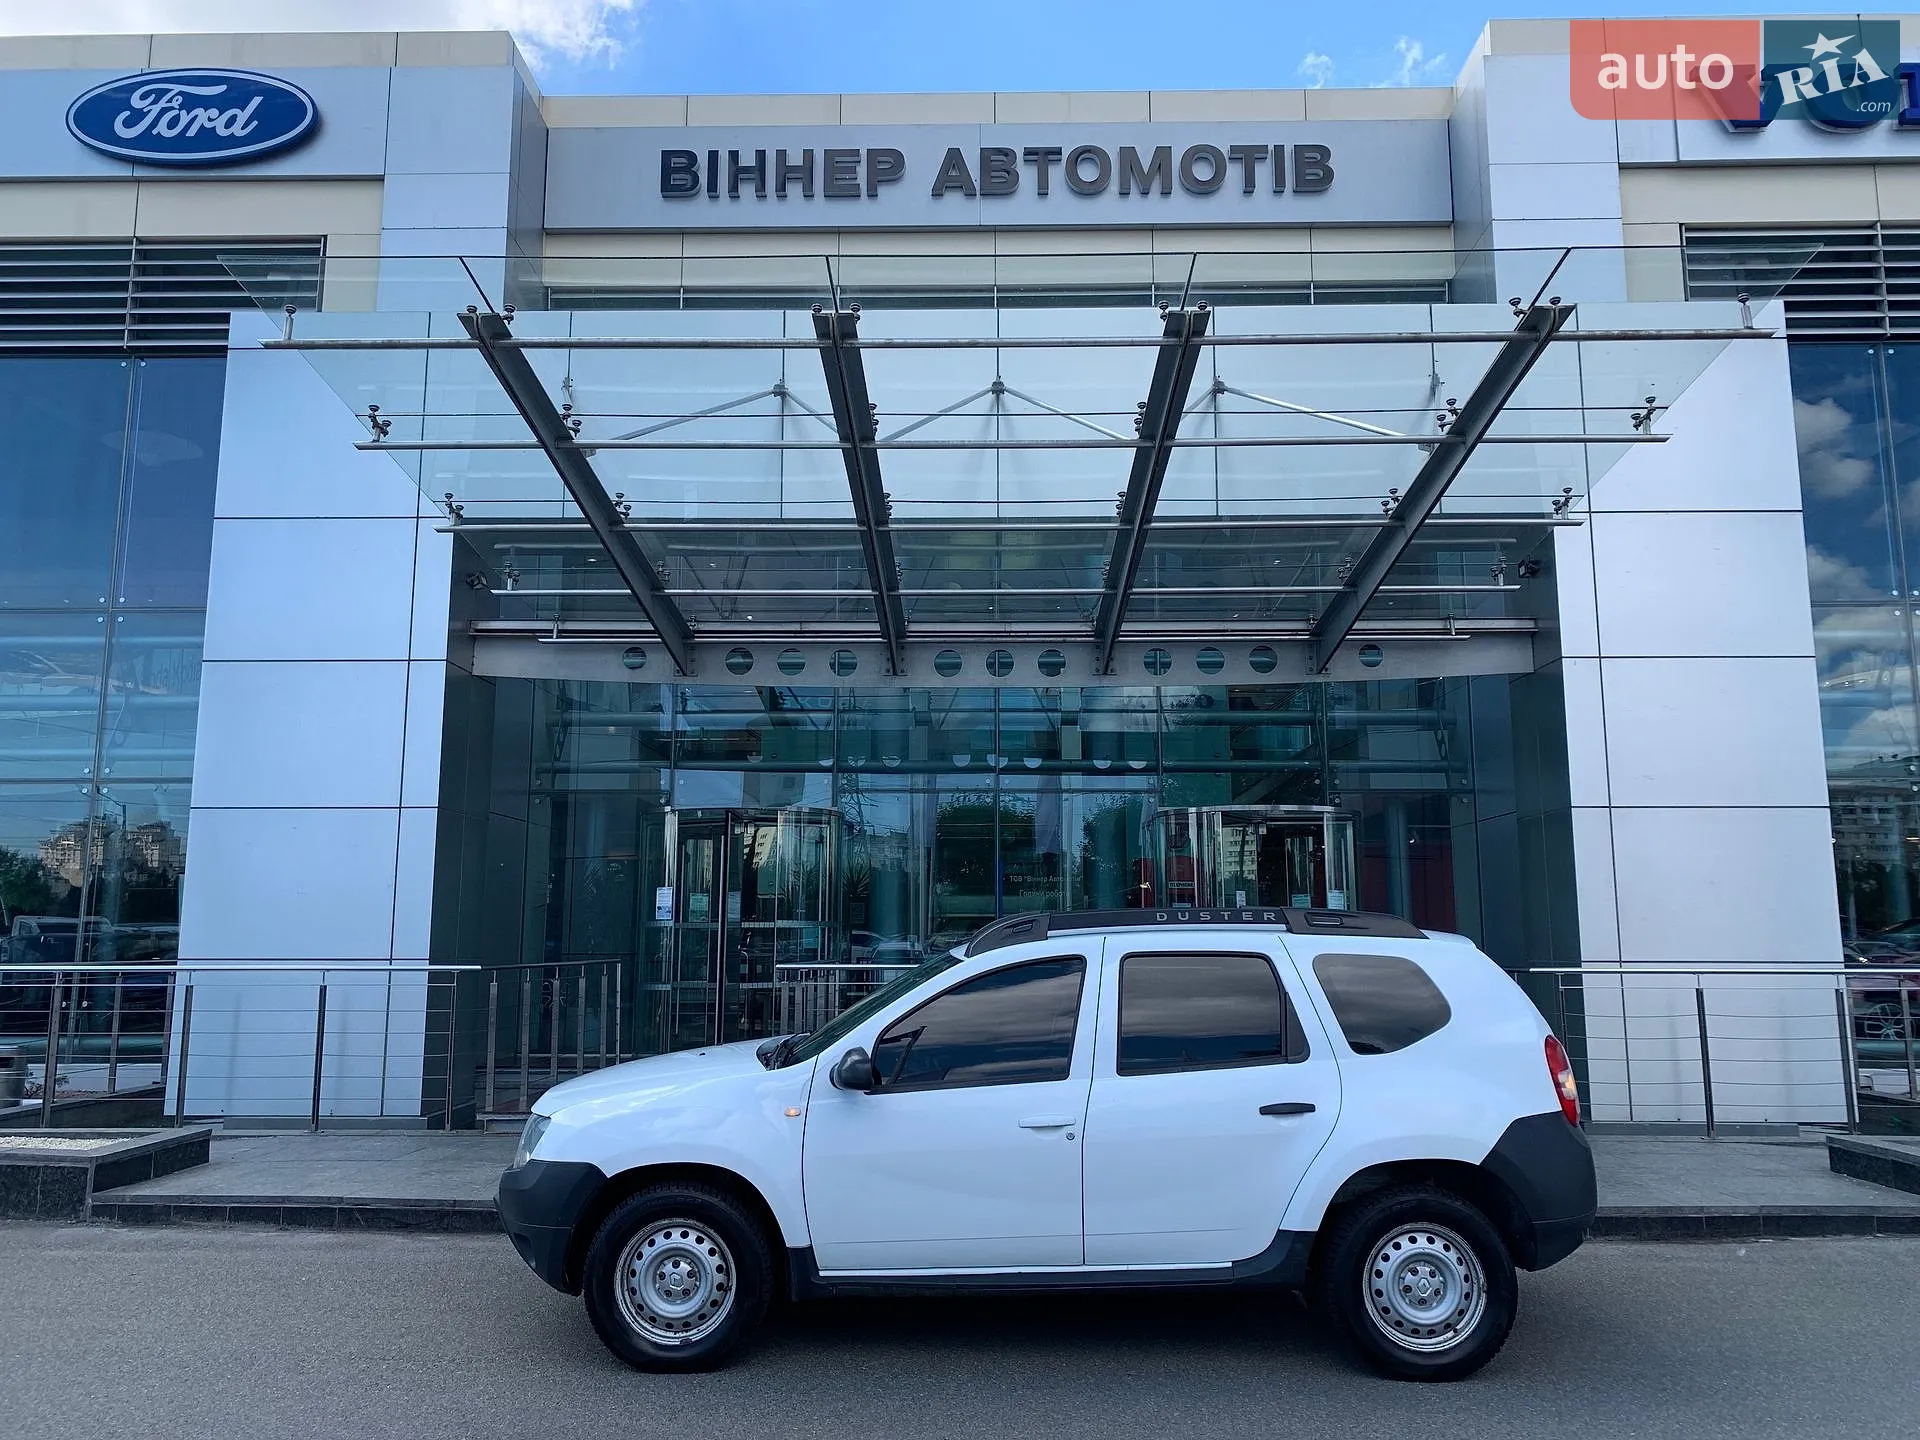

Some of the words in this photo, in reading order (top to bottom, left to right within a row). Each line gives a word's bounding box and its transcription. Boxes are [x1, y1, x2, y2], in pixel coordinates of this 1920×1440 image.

[113, 83, 264, 139] Ford
[659, 147, 906, 199] ВІННЕР
[931, 143, 1335, 197] АВТОМОТІВ
[1156, 911, 1277, 921] DUSTER
